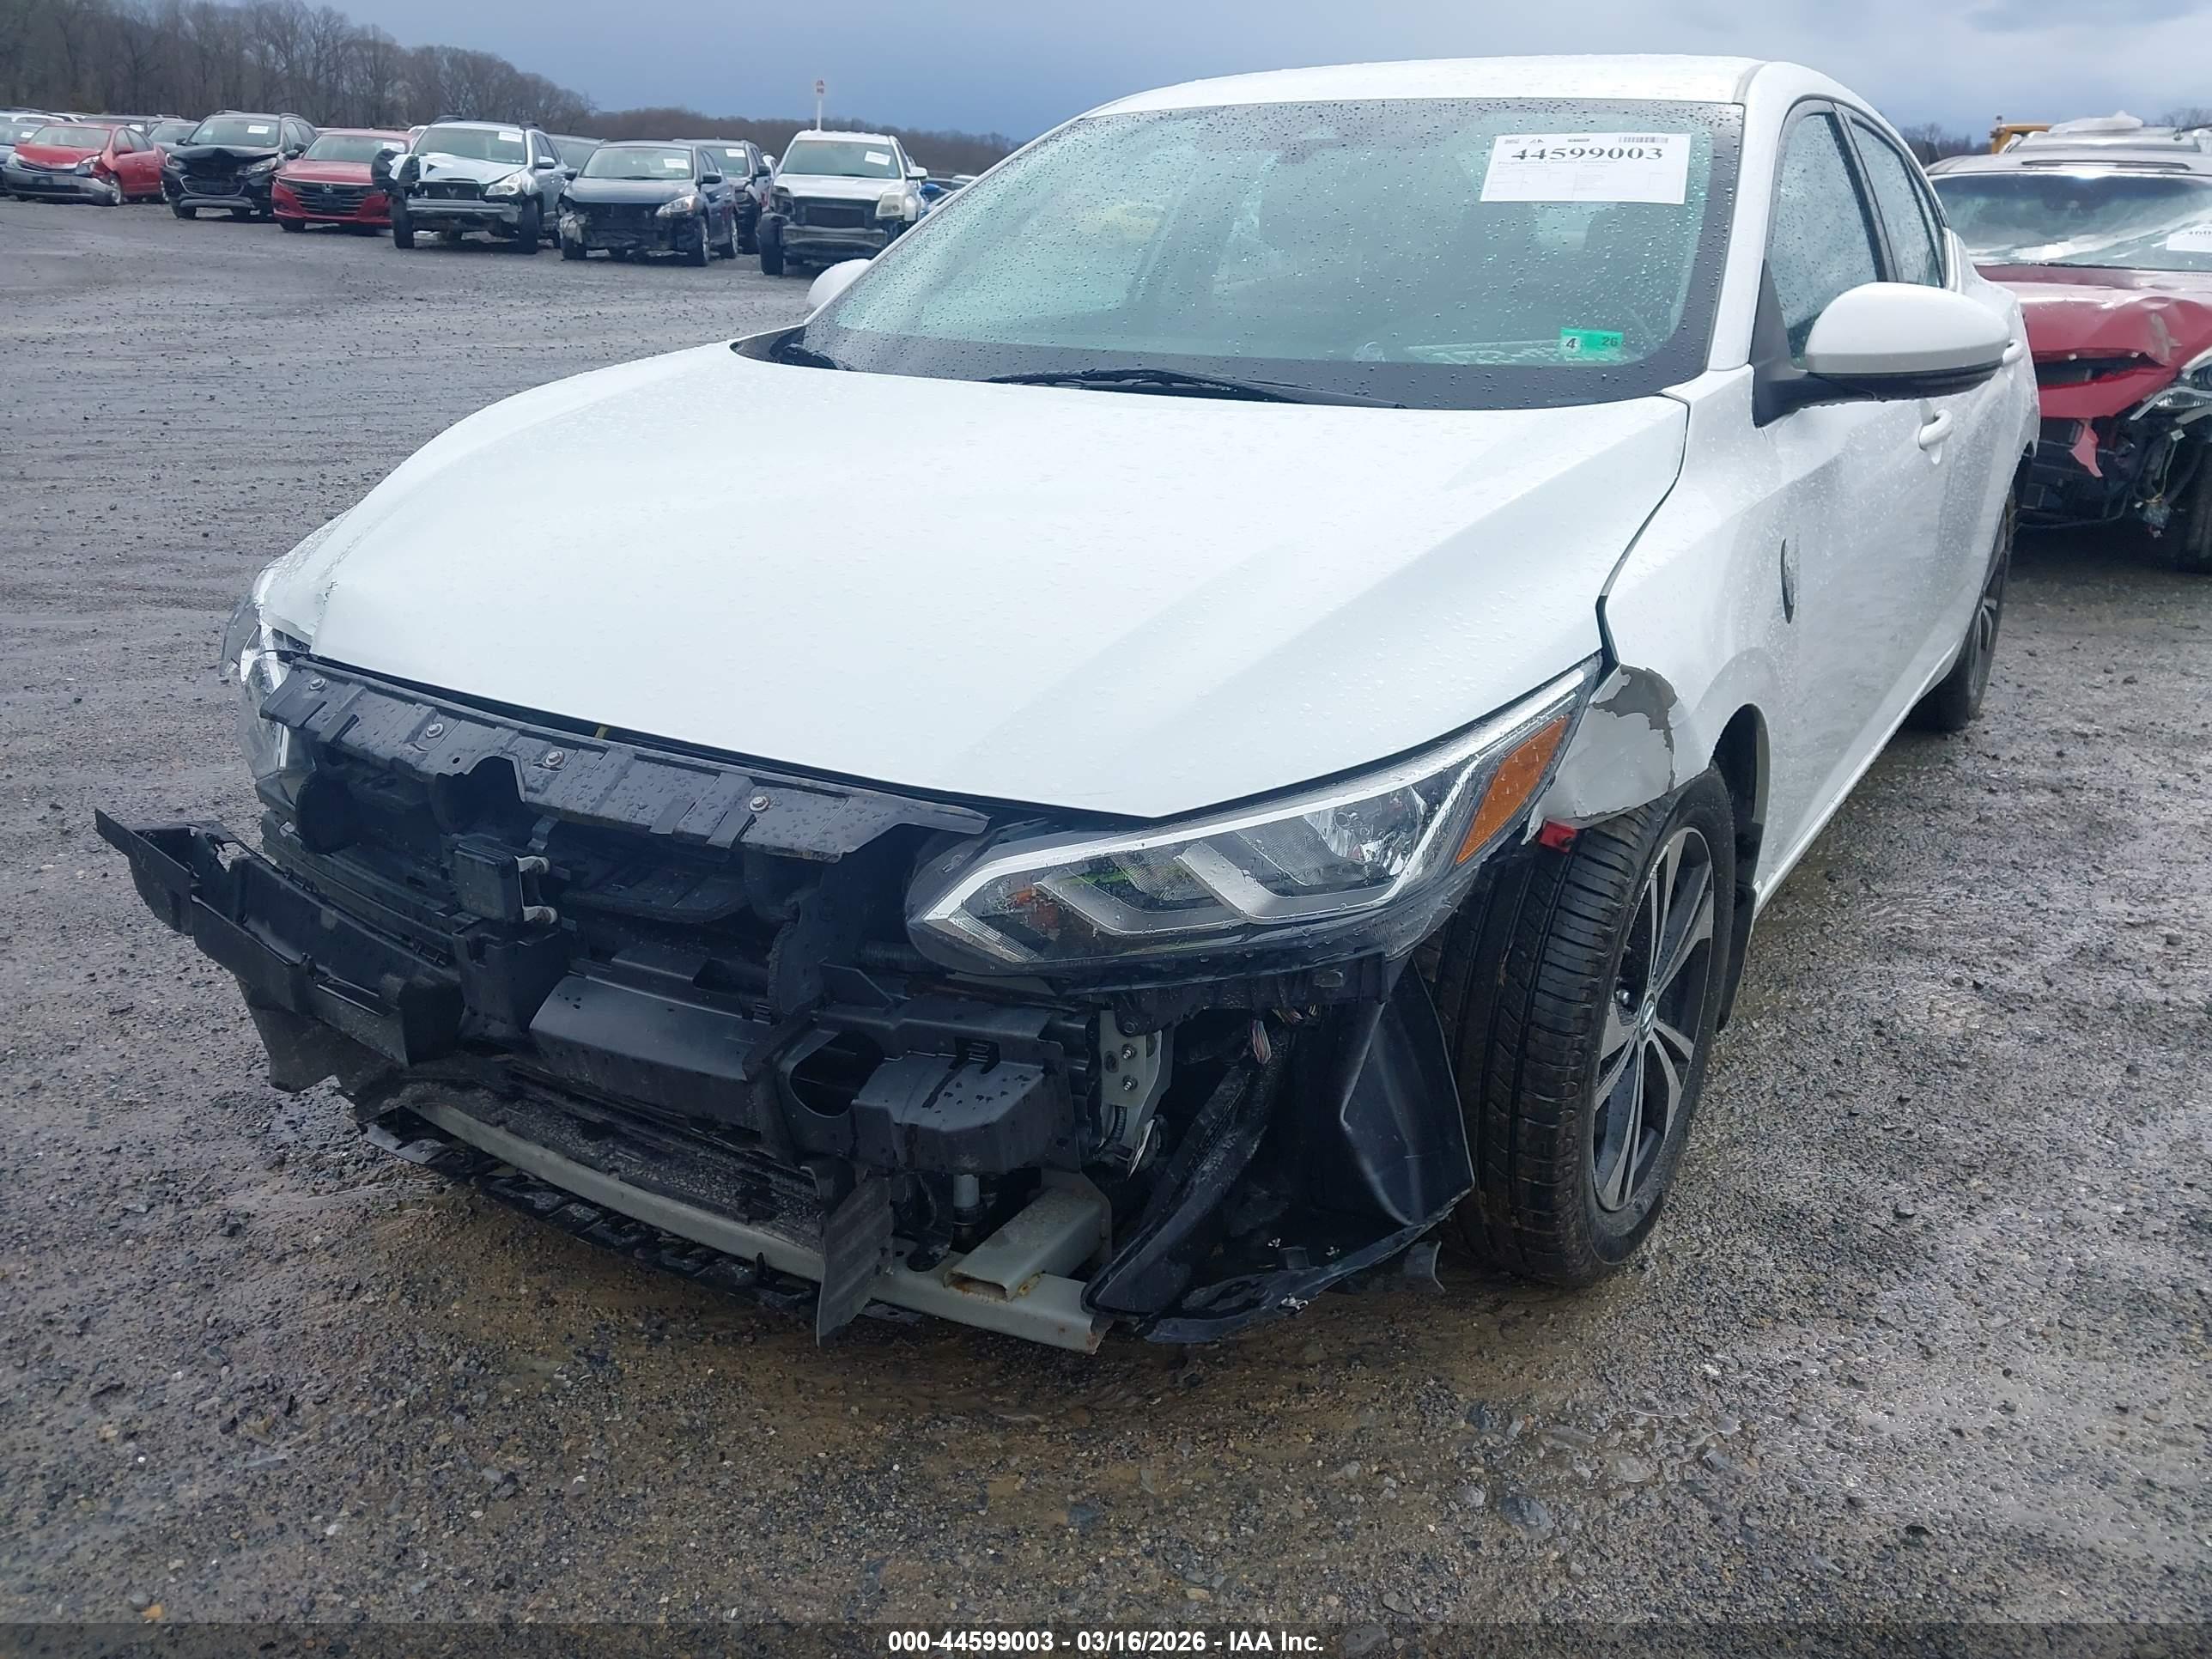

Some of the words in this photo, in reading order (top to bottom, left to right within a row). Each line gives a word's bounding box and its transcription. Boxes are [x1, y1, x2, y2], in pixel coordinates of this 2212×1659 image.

[1511, 147, 1663, 161] 44599003
[1565, 337, 1577, 349] 4
[1602, 336, 1619, 347] 26
